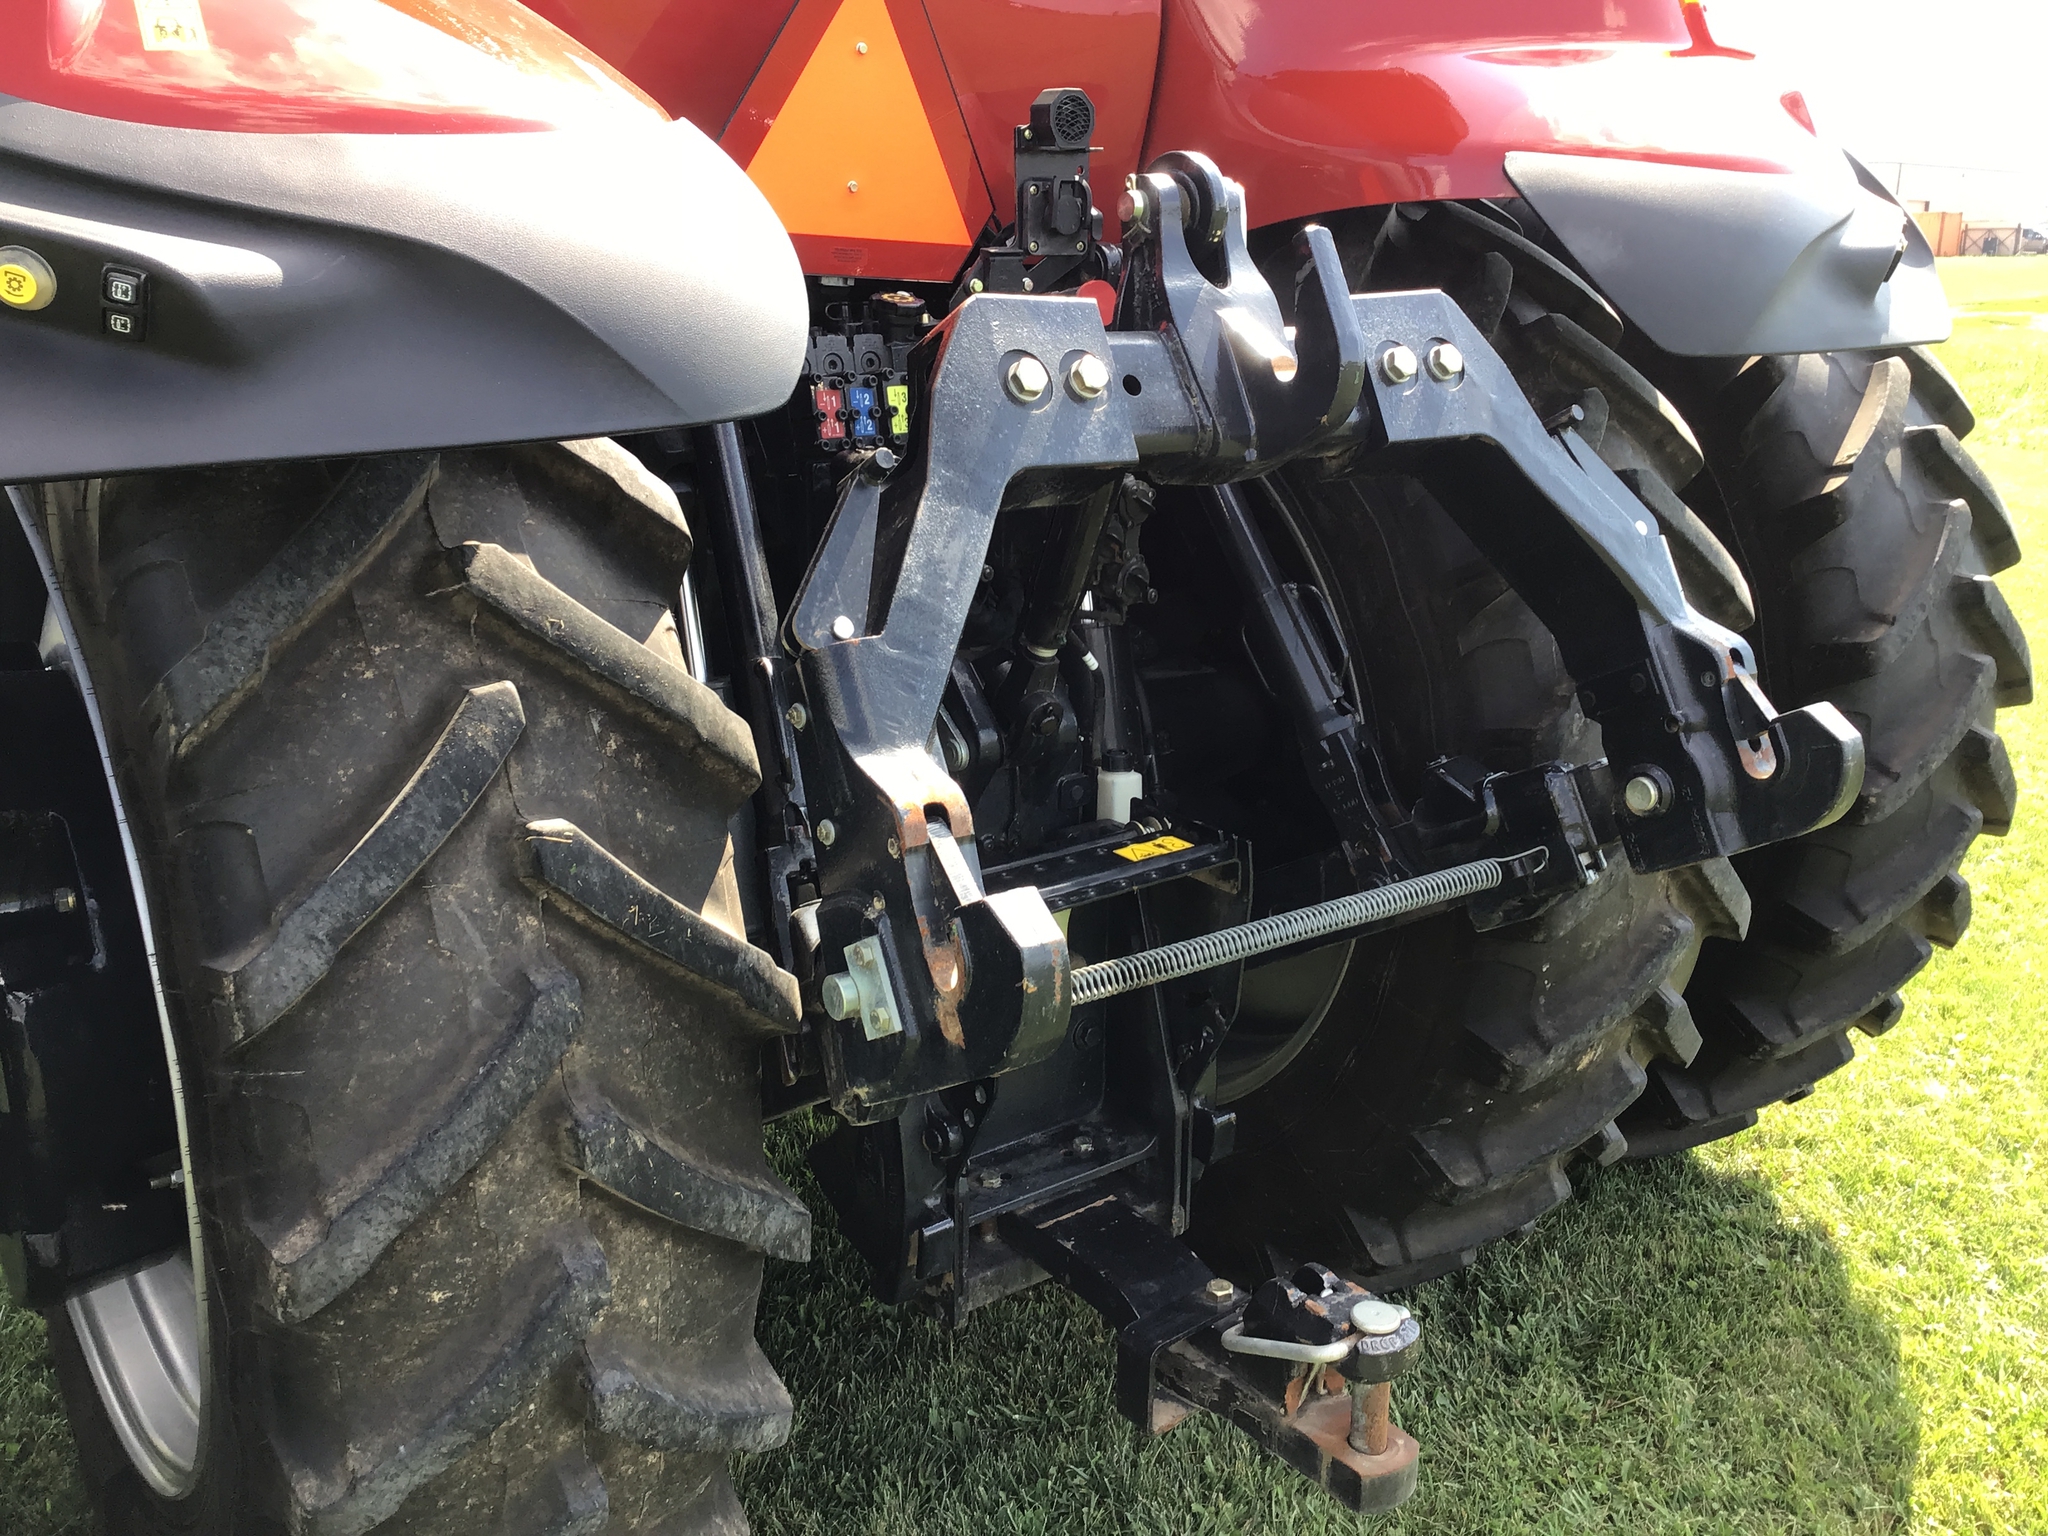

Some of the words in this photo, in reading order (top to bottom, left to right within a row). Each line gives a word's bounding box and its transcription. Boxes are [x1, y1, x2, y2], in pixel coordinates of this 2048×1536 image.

[831, 395, 836, 407] 1
[863, 393, 870, 405] 2
[834, 421, 840, 433] 1
[866, 419, 873, 431] 2
